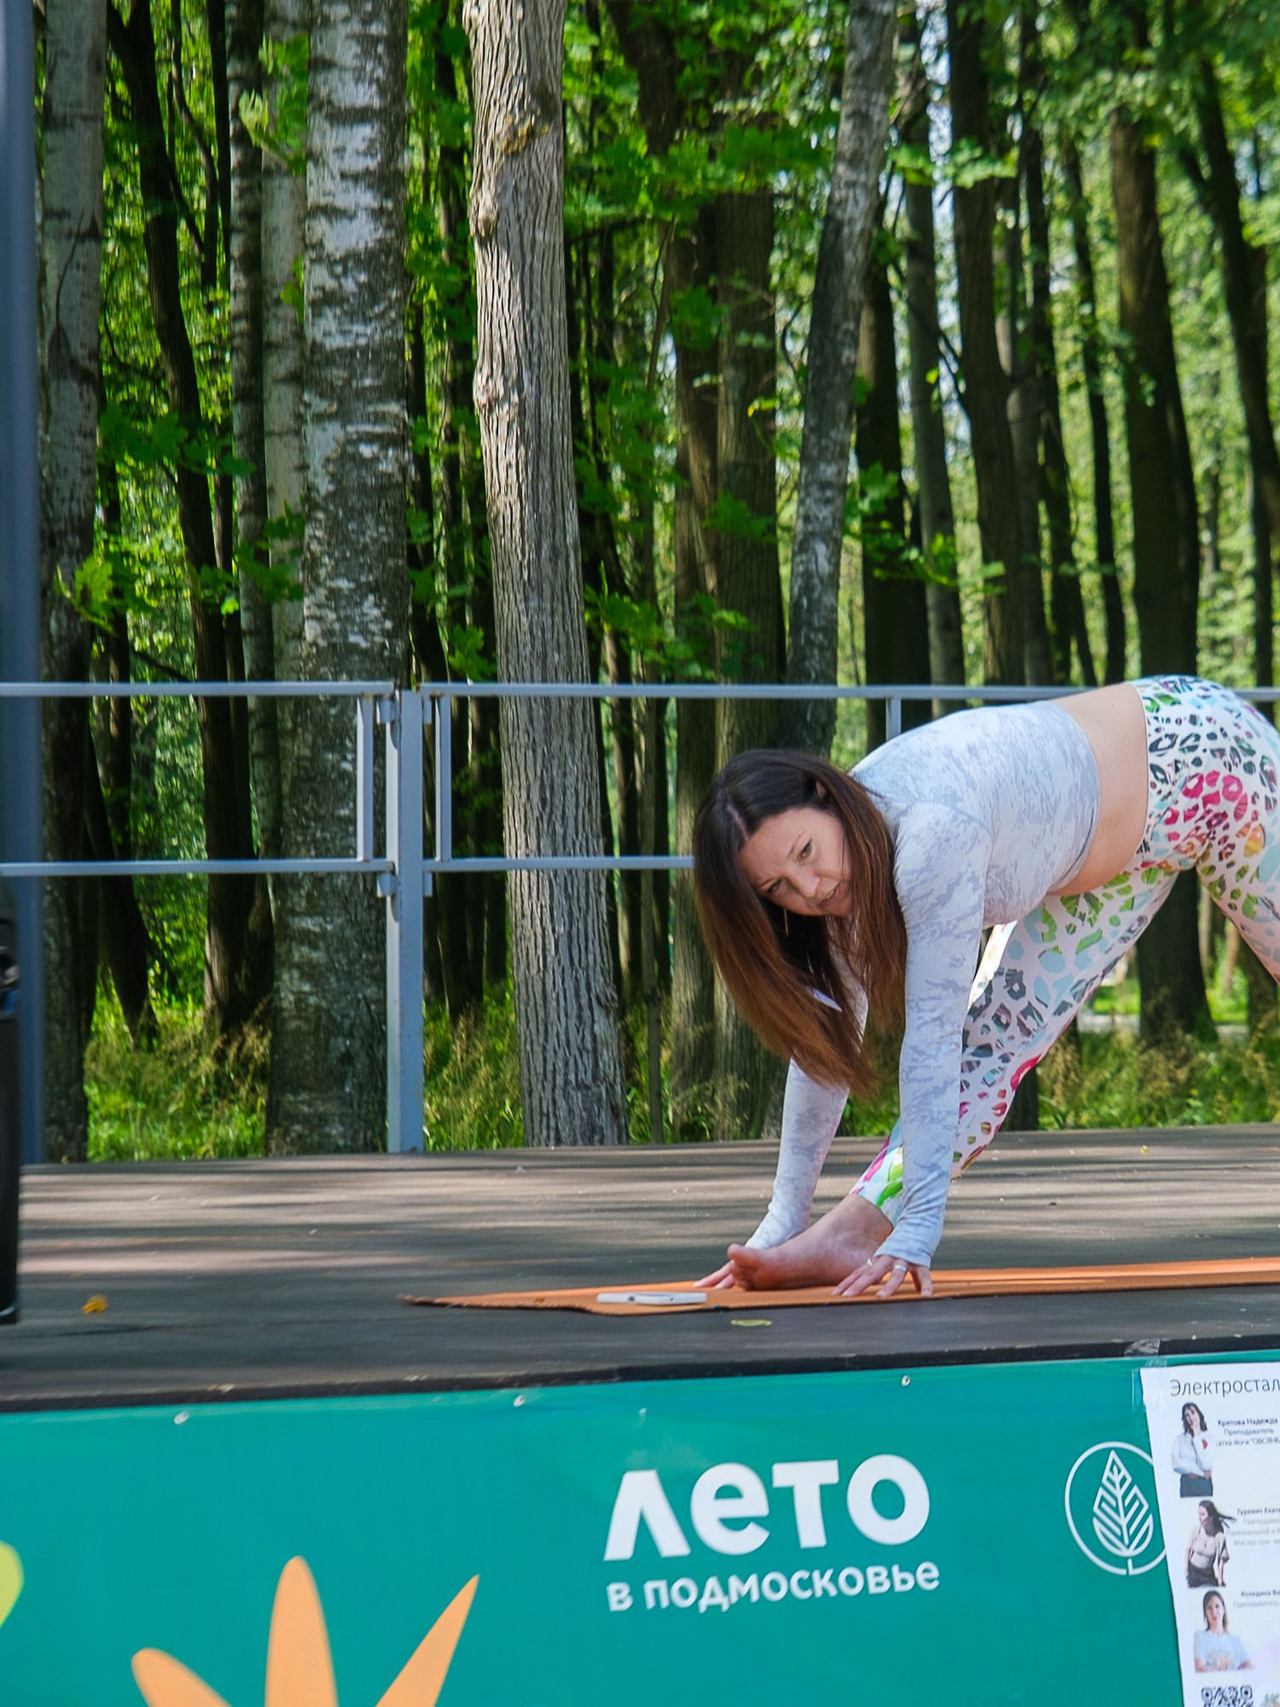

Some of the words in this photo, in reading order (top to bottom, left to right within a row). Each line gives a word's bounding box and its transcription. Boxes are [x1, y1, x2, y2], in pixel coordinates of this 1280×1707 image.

[1247, 1418, 1279, 1427] Надежда
[1223, 1427, 1275, 1436] Преподаватель
[606, 1581, 633, 1612] в
[643, 1560, 940, 1614] подмосковье
